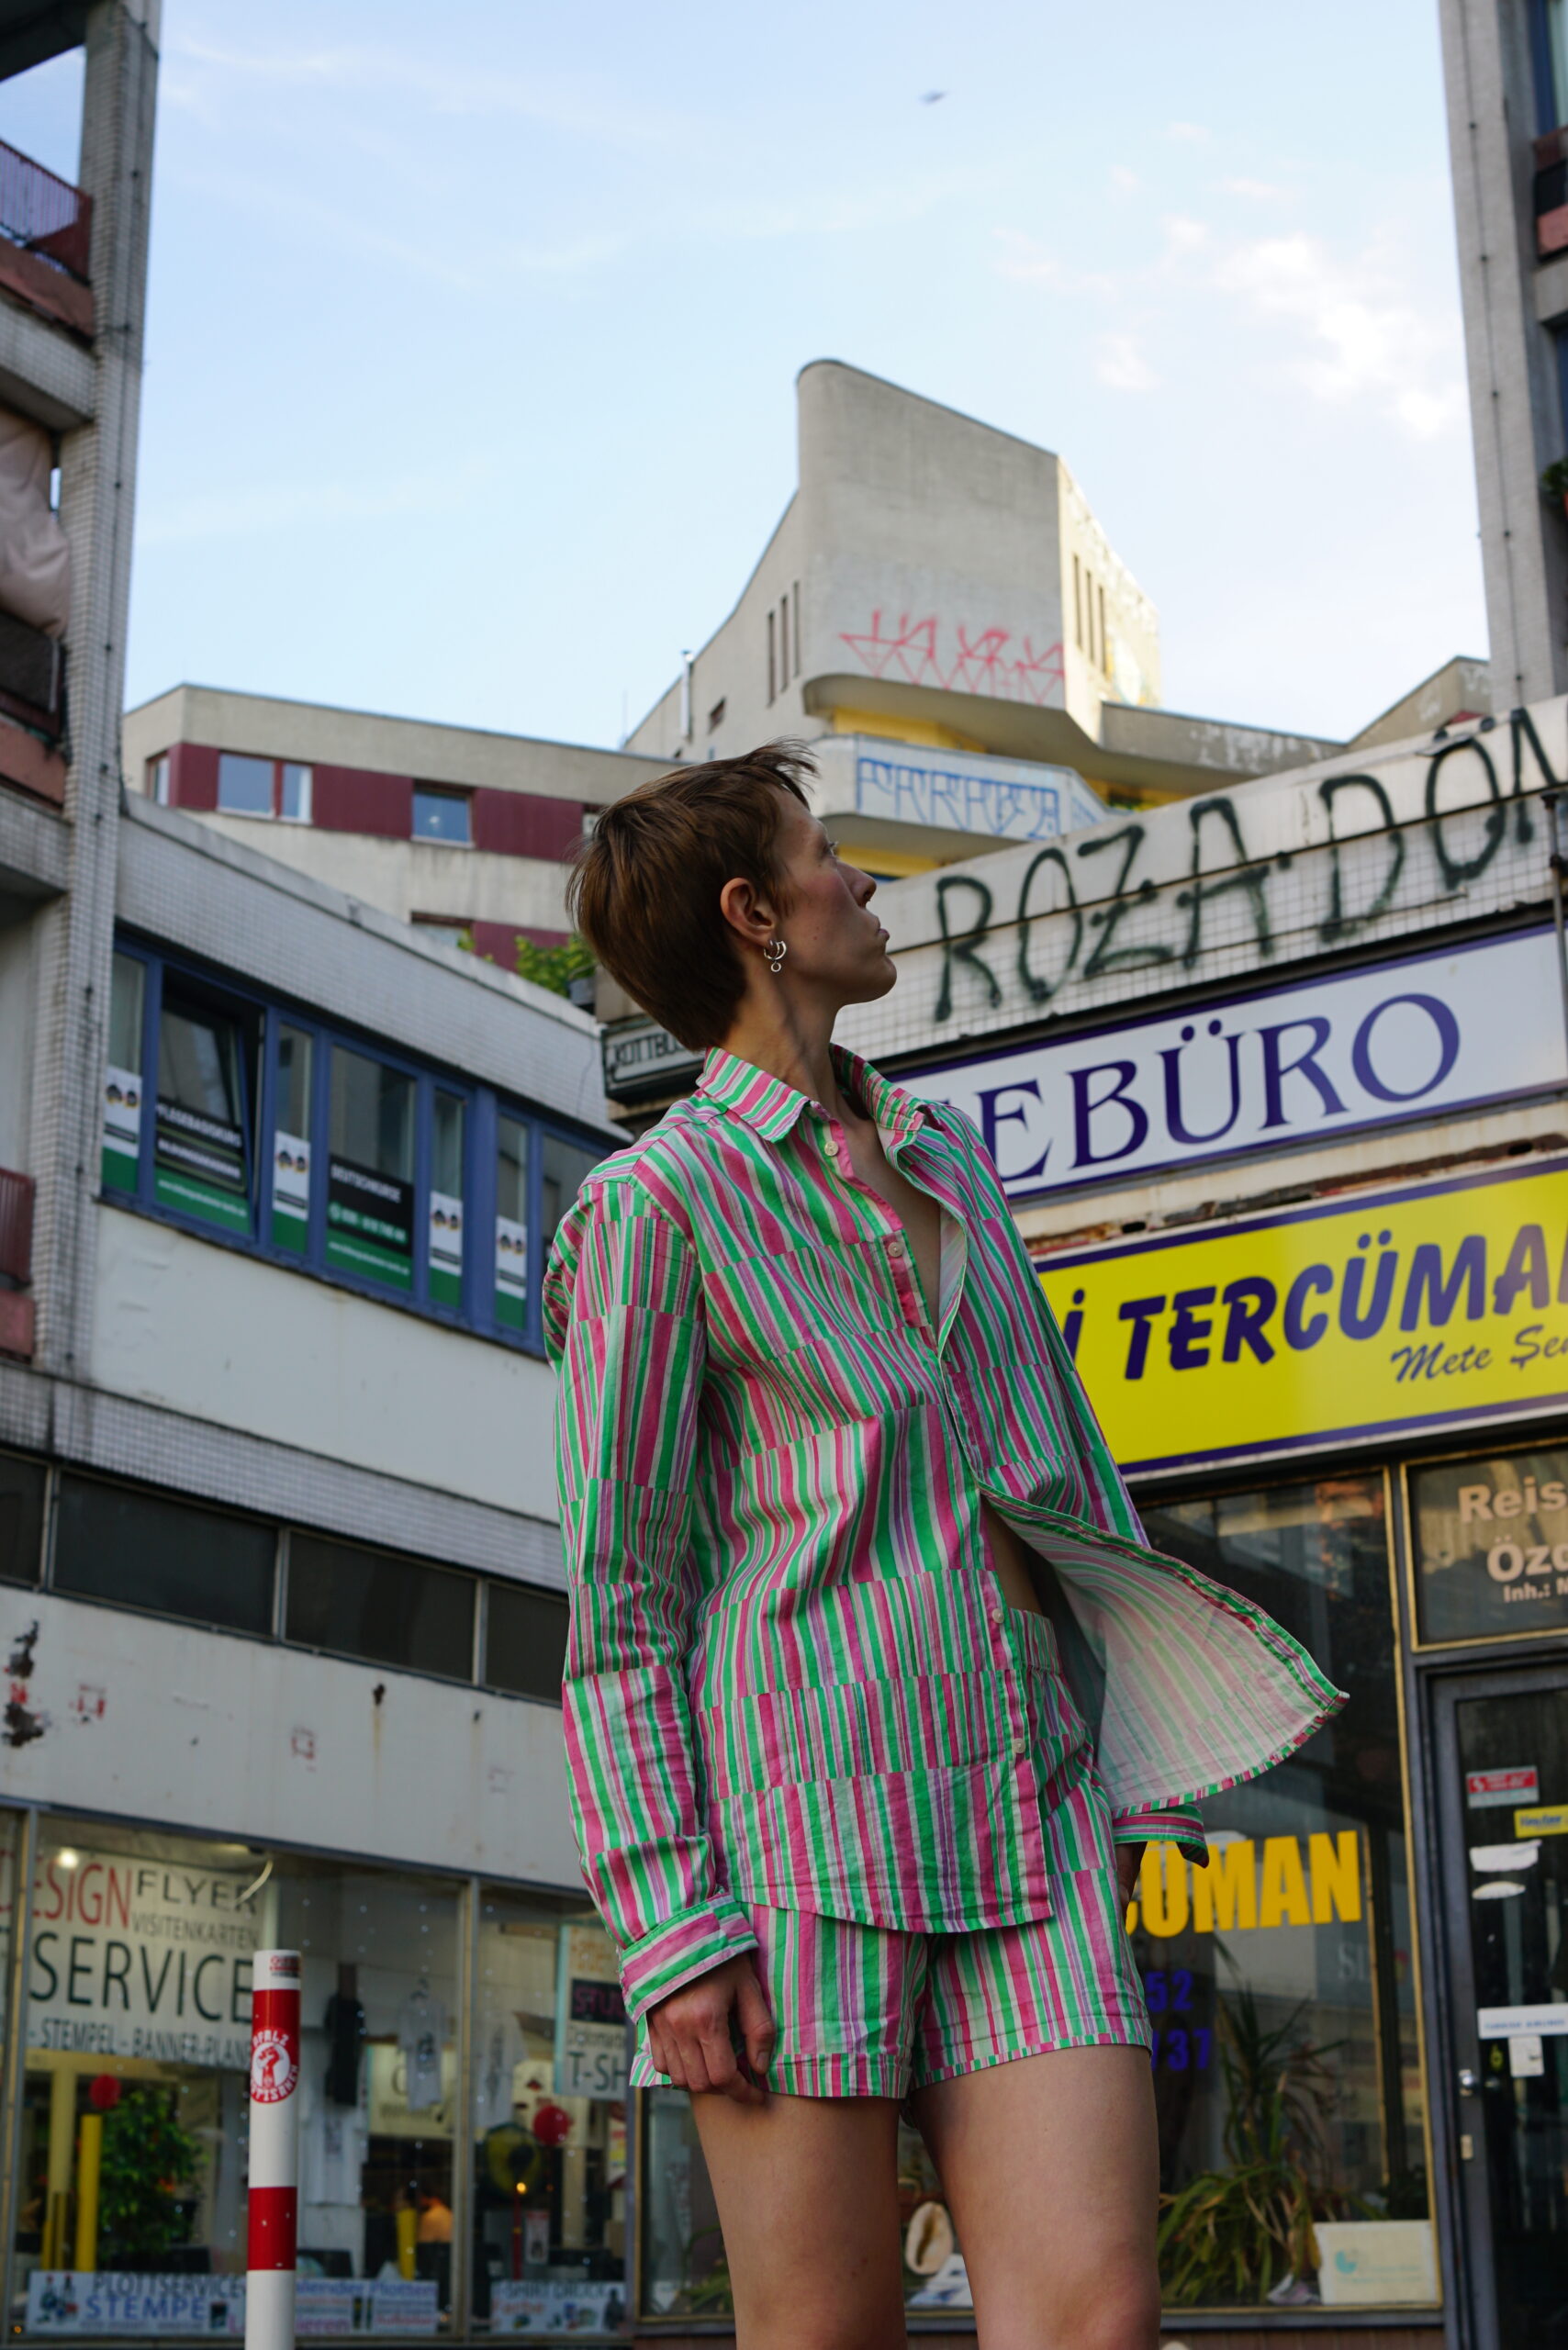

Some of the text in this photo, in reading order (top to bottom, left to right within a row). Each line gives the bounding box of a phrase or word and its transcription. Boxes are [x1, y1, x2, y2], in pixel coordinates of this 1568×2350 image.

[933, 797, 1293, 1024] ROZA
[976, 992, 1462, 1184] EBÜRO
[1118, 1224, 1568, 1380] TERCÜMA
[1390, 1342, 1493, 1383] Mete
[137, 1869, 259, 1916] FLYER
[29, 1930, 253, 2025] SERVICE
[41, 2018, 116, 2056] STEMPEL
[252, 2029, 290, 2048] PFALZ
